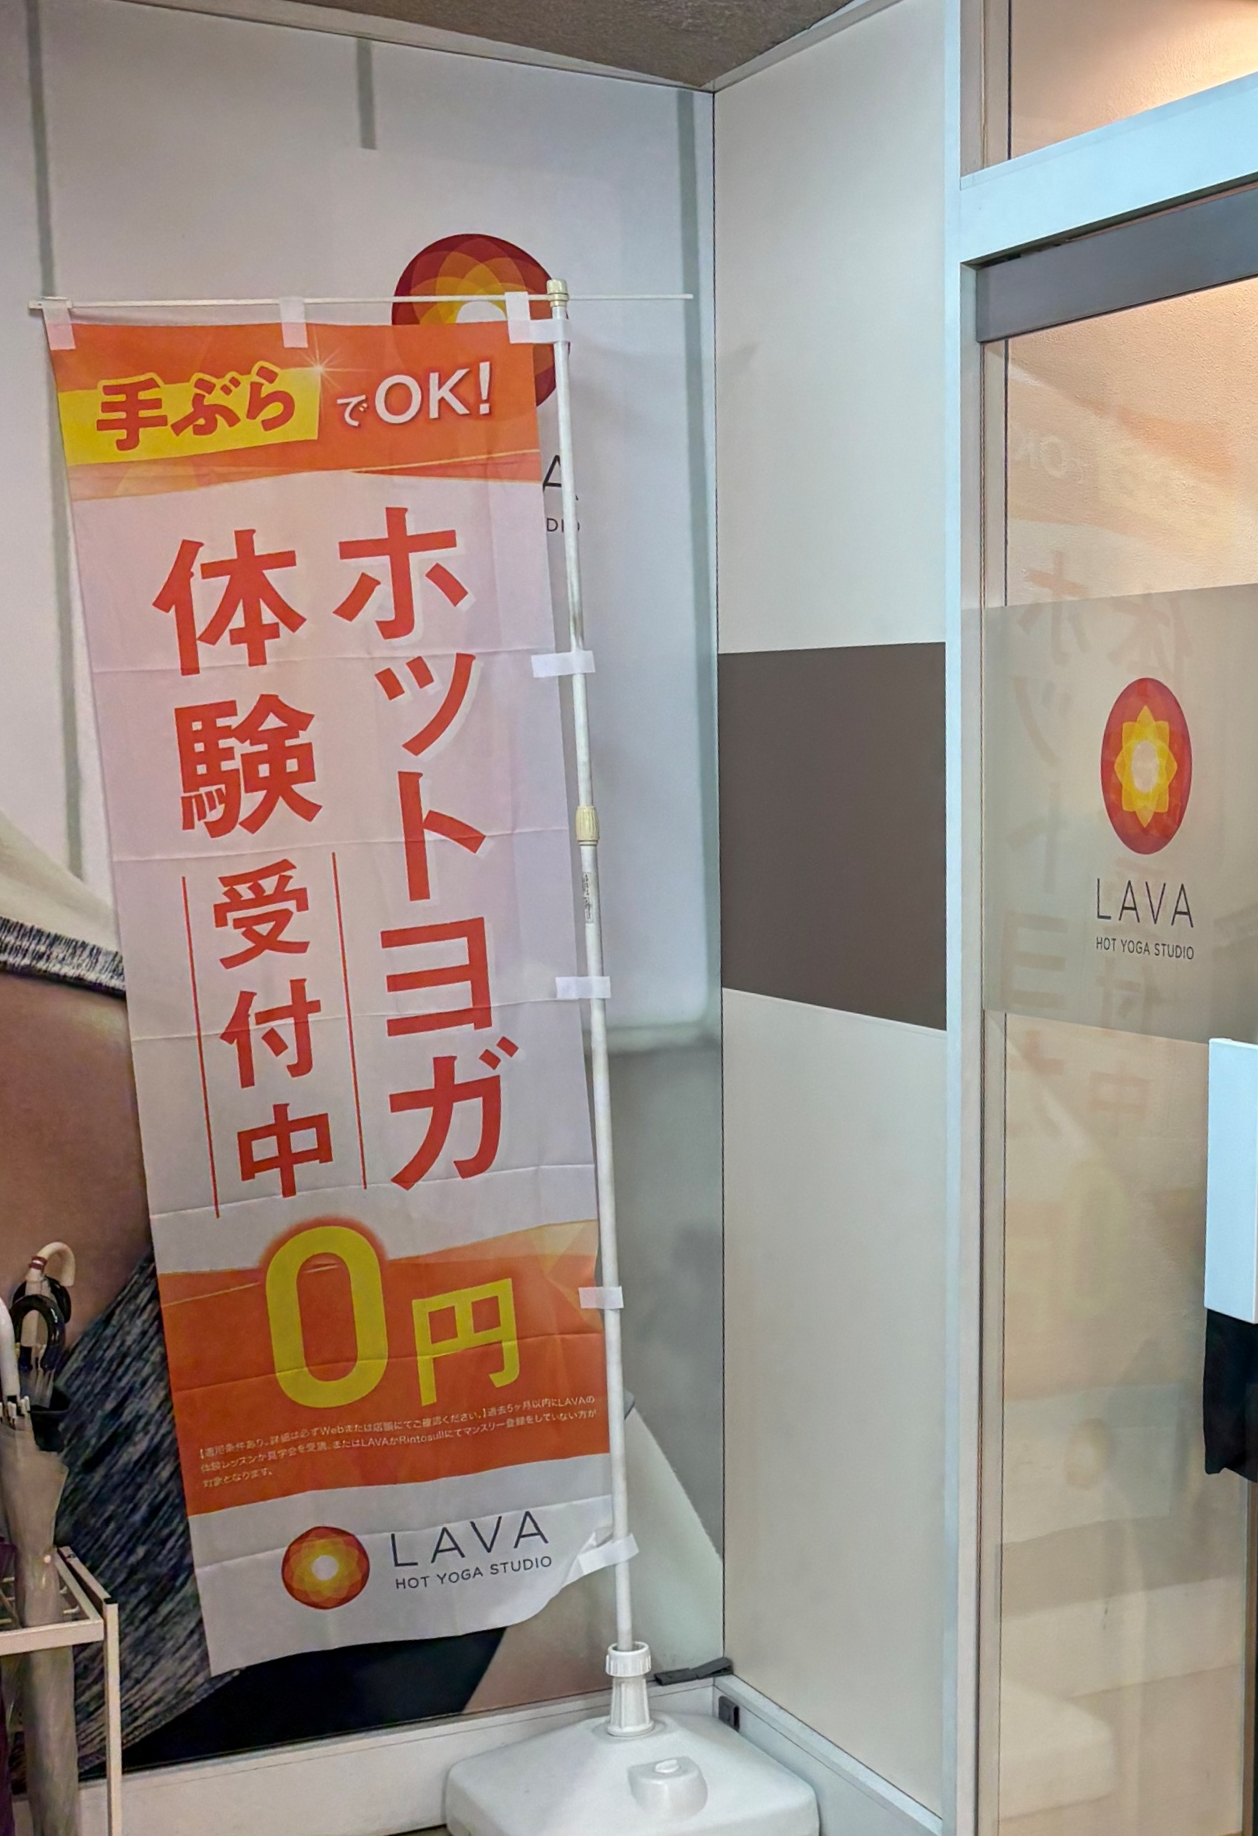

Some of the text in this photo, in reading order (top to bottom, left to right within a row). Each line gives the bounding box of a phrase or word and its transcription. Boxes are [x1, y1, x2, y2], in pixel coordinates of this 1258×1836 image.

[152, 529, 333, 1198] 体験受付中
[333, 507, 518, 1190] ホットヨガ
[1096, 878, 1194, 928] LAVA
[1096, 936, 1194, 960] HOT YOGA STUDIO
[264, 1225, 520, 1409] 0円
[392, 1510, 548, 1568] LAVA
[395, 1555, 553, 1591] HOT YOGA STUDIO
